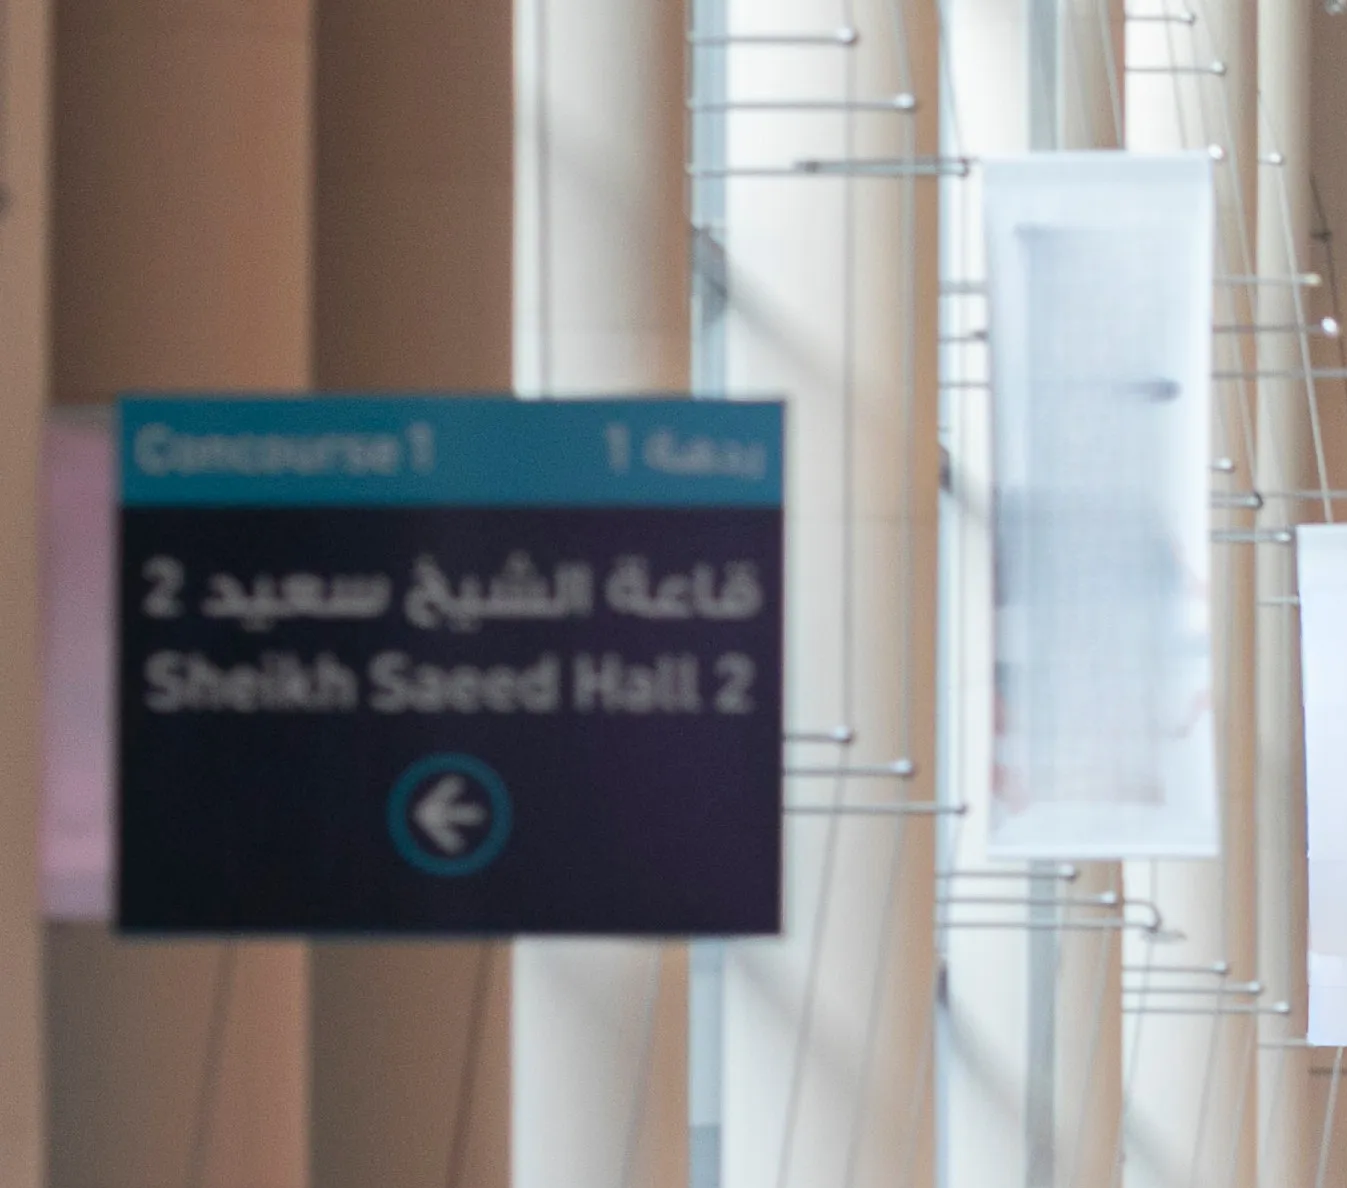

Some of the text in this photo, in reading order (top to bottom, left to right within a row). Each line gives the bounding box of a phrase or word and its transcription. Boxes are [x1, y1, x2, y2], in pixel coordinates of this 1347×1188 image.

[134, 422, 435, 476] Concourse 1
[141, 551, 763, 633] قاعة الشيخ سعيد 2
[143, 650, 756, 714] Sheikh Saeed Hall 2
